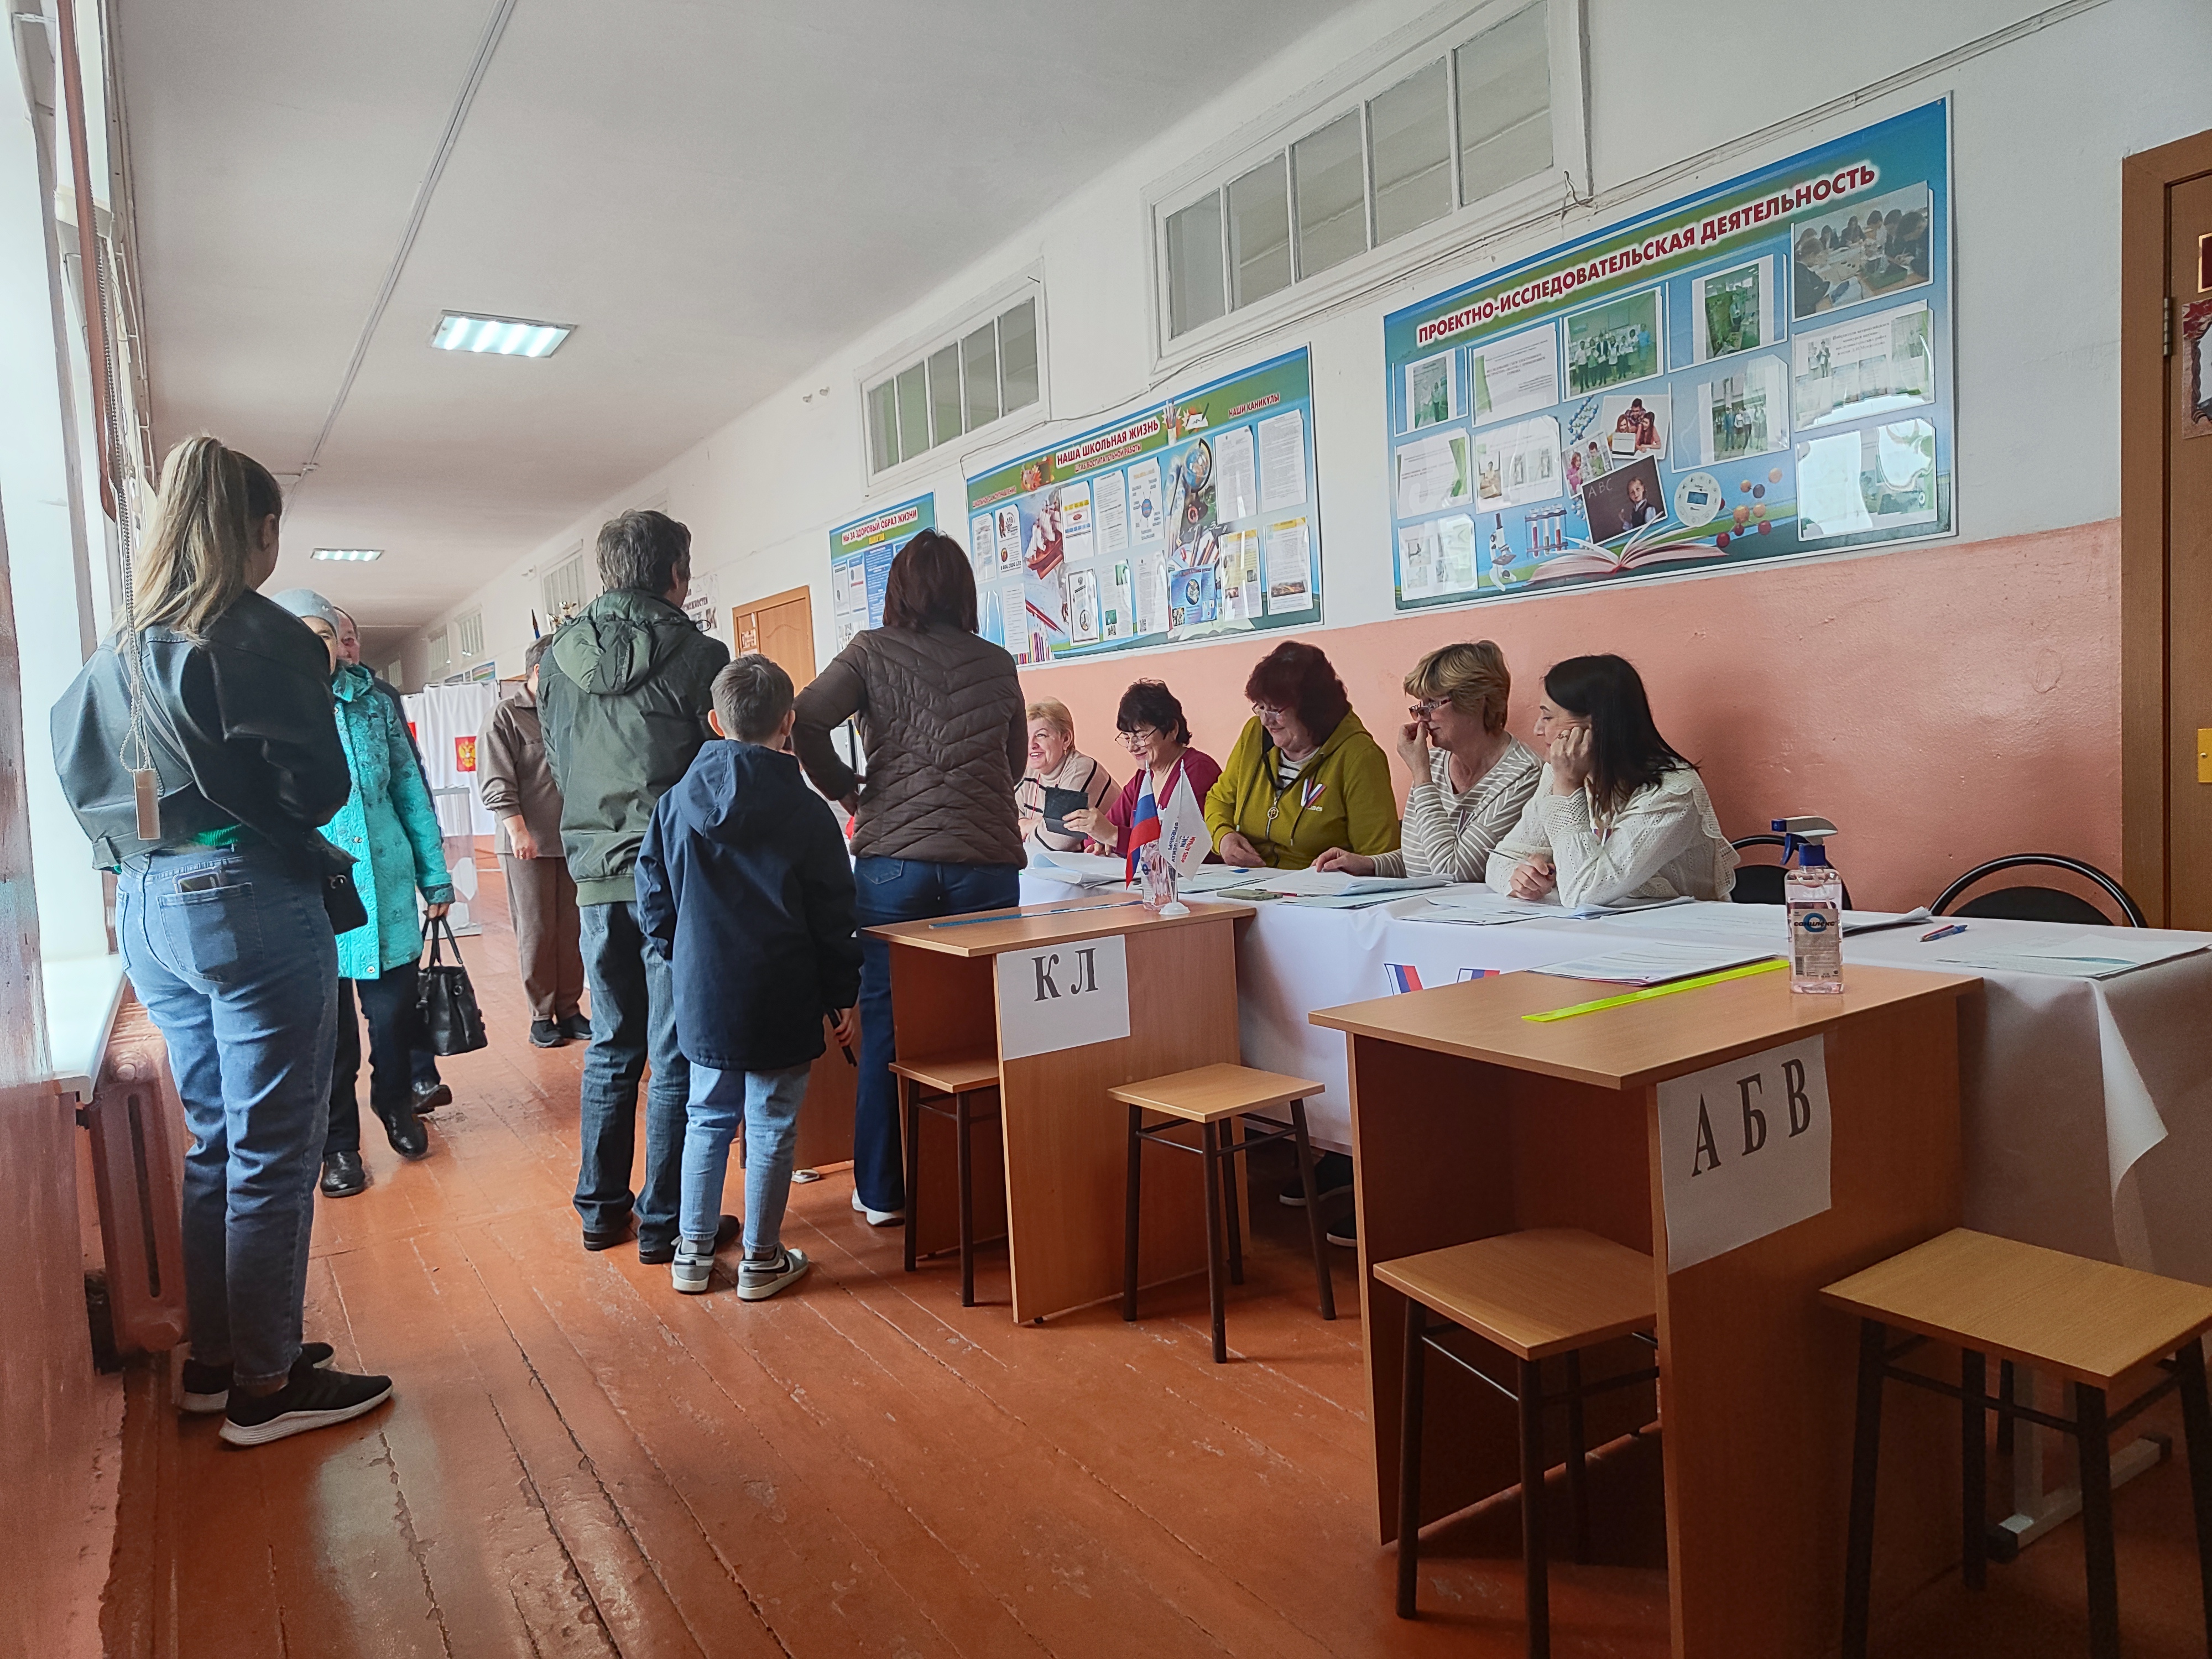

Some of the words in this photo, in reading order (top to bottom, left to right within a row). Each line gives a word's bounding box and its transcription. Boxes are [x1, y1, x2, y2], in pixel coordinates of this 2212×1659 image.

[1419, 227, 1695, 343] ПРОЕКТНО-ИССЛЕДОВАТЕЛЬСКАЯ
[1700, 165, 1875, 244] ДЕЯТЕЛЬНОСТЬ
[1229, 405, 1246, 418] НАШИ
[1247, 393, 1279, 411] КАНИКУЛЫ
[1057, 448, 1081, 465] НАША
[1082, 431, 1127, 457] ШКОЛЬНАЯ
[1129, 420, 1159, 441] ЖИЗНЬ
[1087, 447, 1124, 468] ВОСПИТАТЕЛЬНОЙ
[1125, 444, 1141, 455] РАБОТЫ
[856, 520, 880, 538] ЗДОРОВЫЙ
[881, 516, 897, 529] ОБРАЗ
[898, 509, 917, 523] ЖИЗНИ
[1031, 954, 1062, 1001] К
[1071, 947, 1099, 994] Л
[1692, 1093, 1721, 1177] А
[1736, 1073, 1767, 1156] Б
[1781, 1058, 1811, 1138] В
